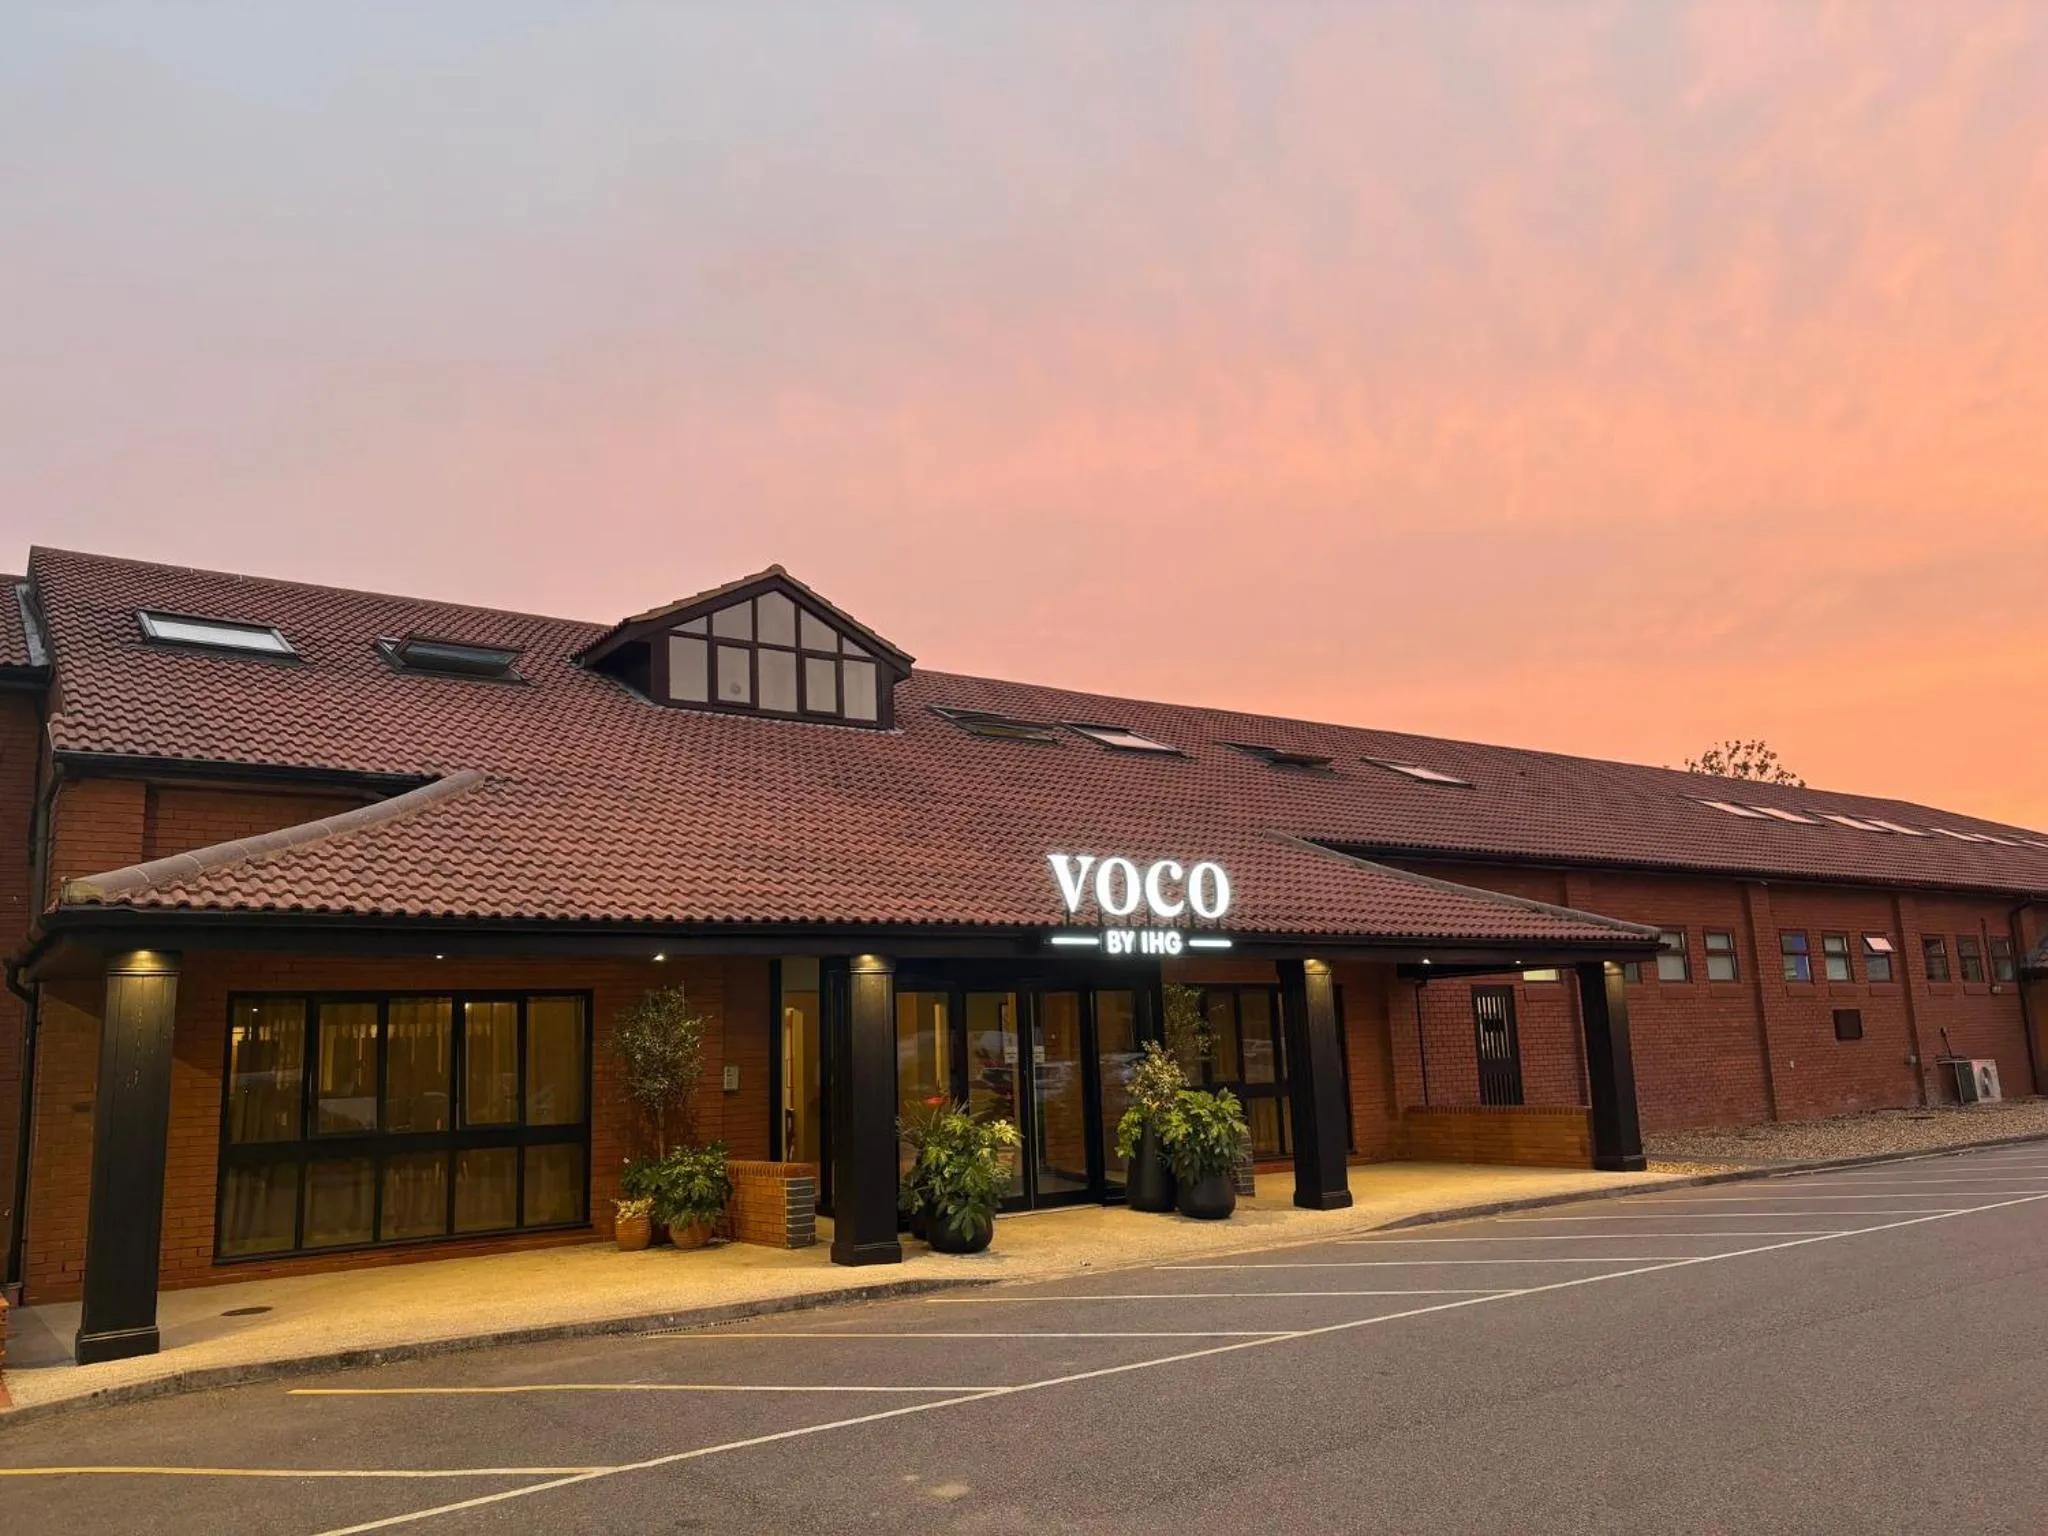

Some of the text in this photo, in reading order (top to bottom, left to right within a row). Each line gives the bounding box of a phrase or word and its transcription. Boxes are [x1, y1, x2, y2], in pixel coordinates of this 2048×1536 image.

[1047, 854, 1230, 918] VOCO
[1107, 930, 1182, 954] BY IHG
